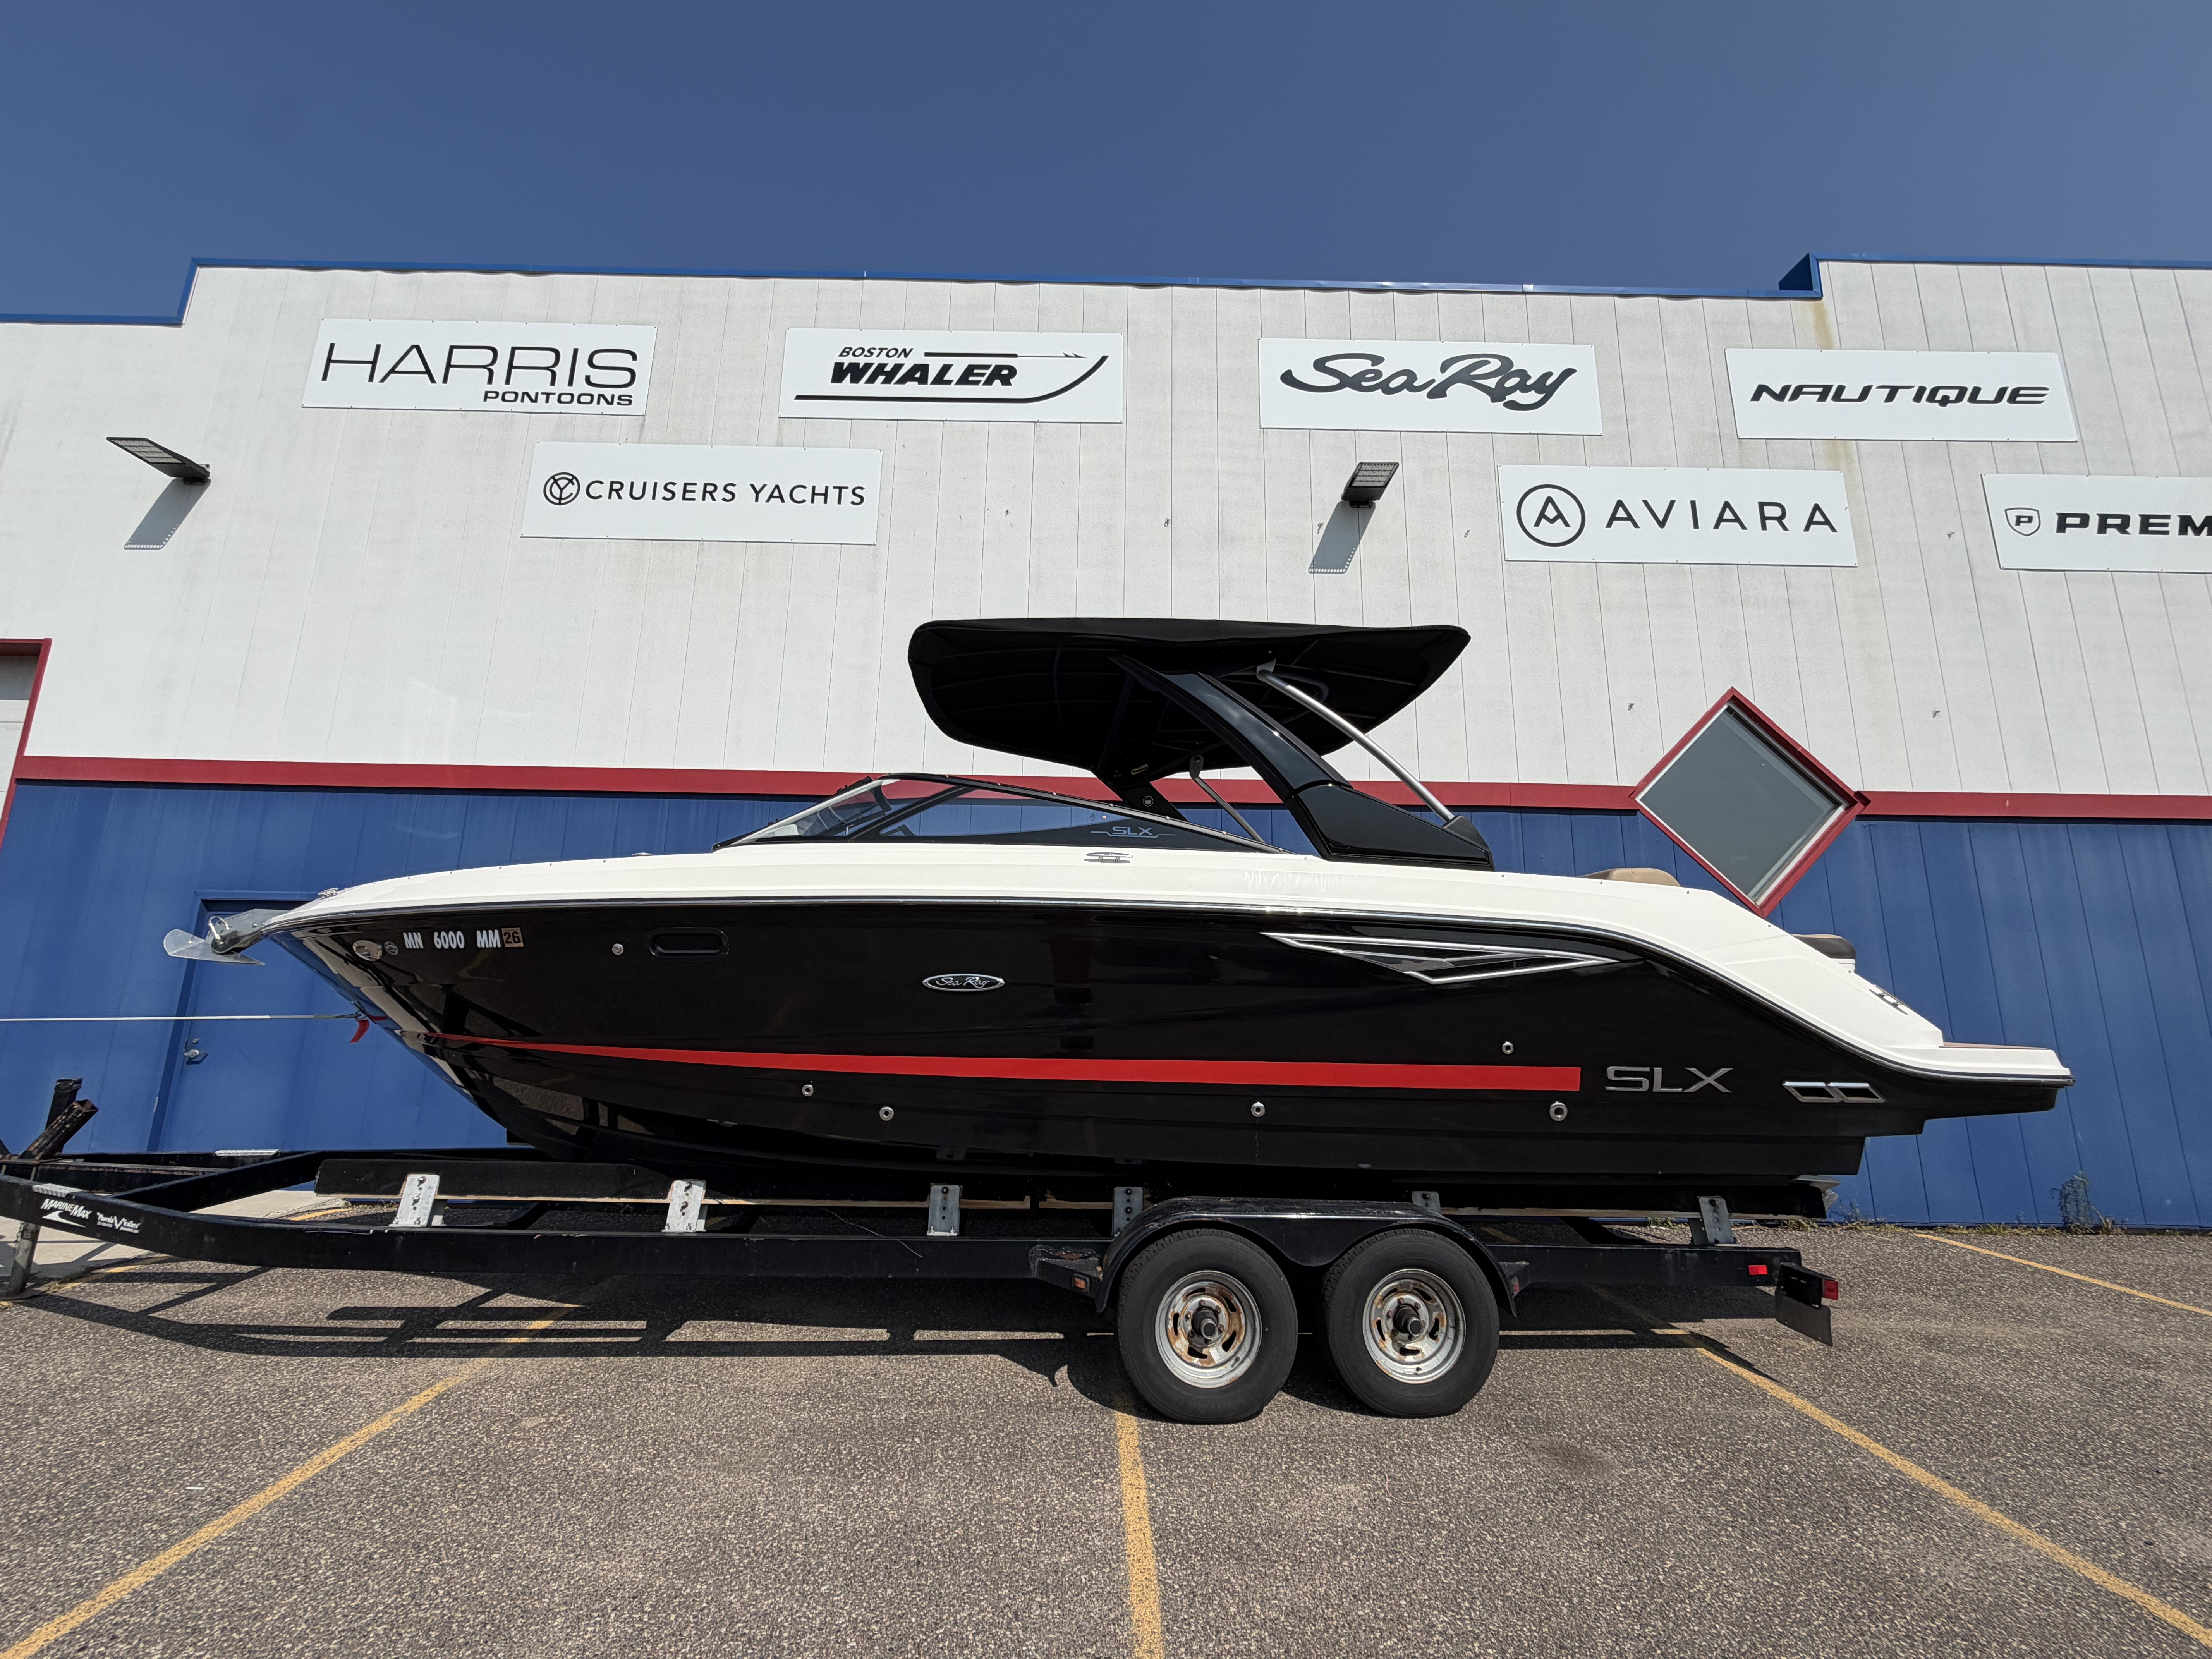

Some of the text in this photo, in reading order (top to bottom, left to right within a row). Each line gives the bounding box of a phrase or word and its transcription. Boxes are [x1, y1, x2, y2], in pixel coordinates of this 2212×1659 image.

[838, 347, 914, 358] BOSTON
[322, 343, 637, 389] HARRIS
[830, 362, 1017, 386] WHALER
[1280, 353, 1577, 411] Sea Ray
[483, 390, 633, 406] PONTOONS
[1750, 384, 2049, 407] NAUTIQUE
[586, 480, 737, 502] CRUISERS
[749, 484, 865, 506] YACHTS
[1605, 499, 1838, 533] AVIARA
[2056, 513, 2212, 536] PREM
[1112, 826, 1154, 835] SLX
[403, 929, 501, 949] MN 6000 MM
[504, 931, 520, 944] 26
[936, 977, 990, 988] Sea Ray
[1604, 1066, 1733, 1093] SLX
